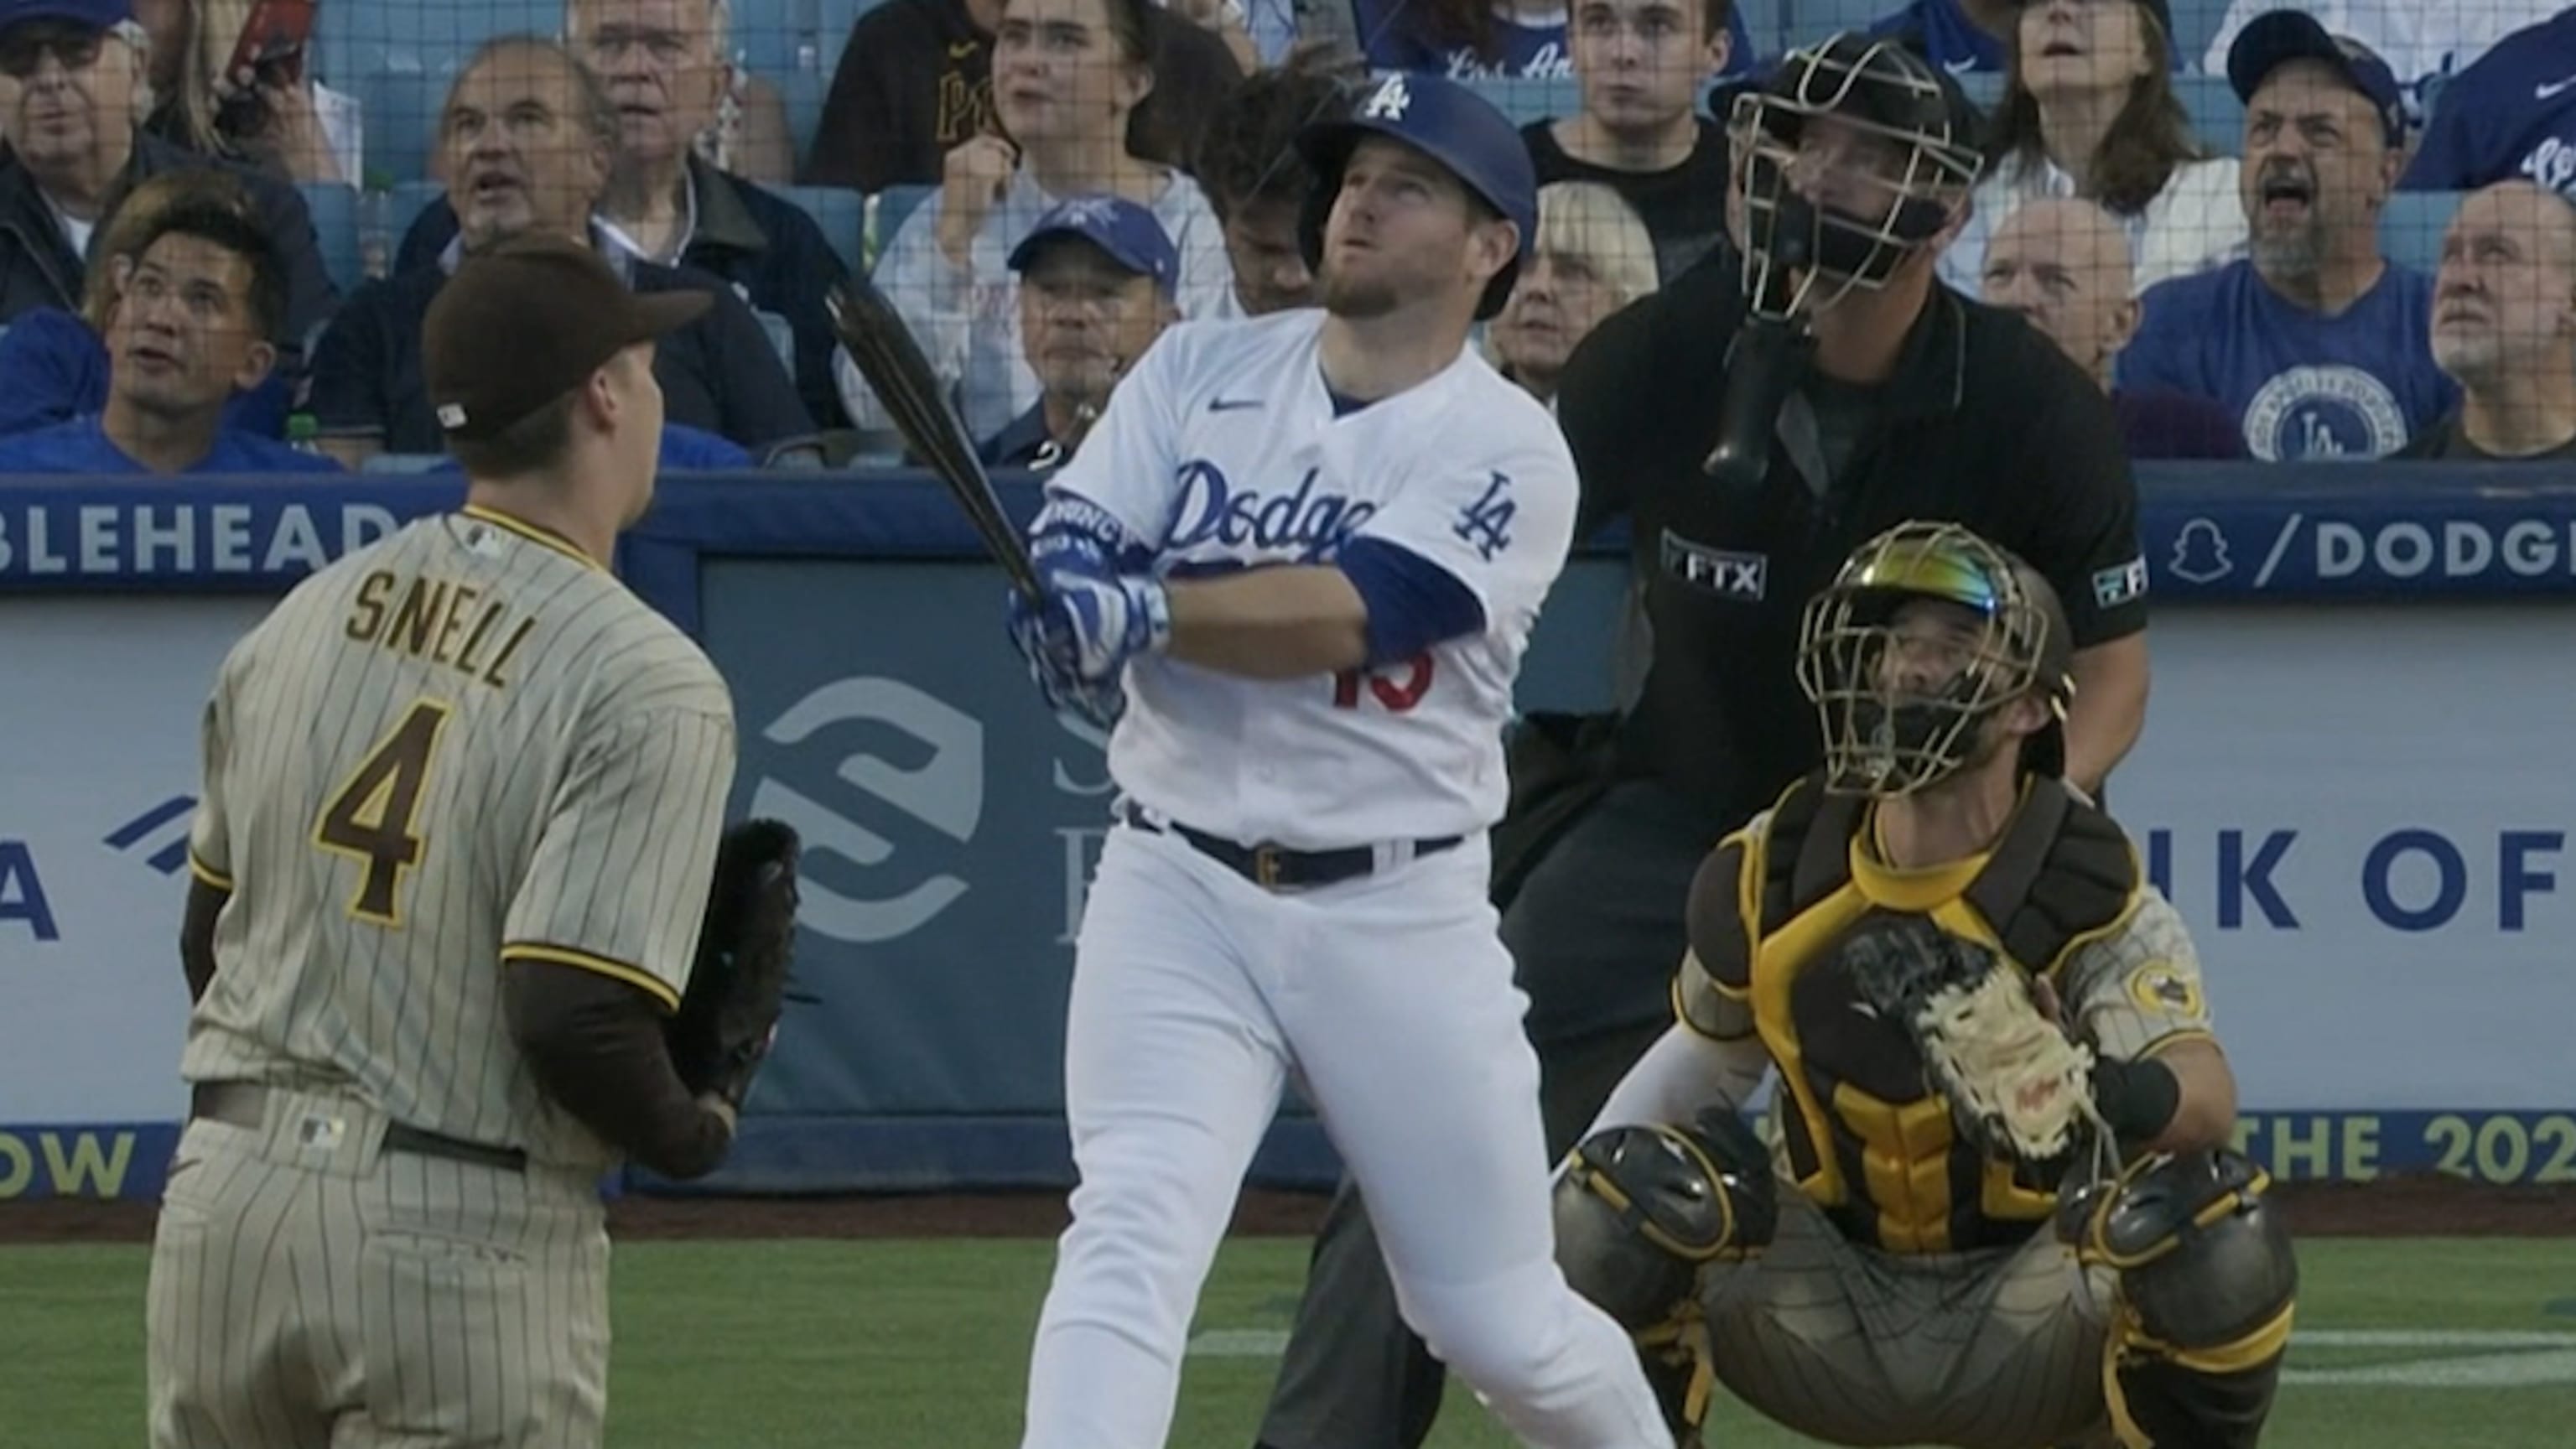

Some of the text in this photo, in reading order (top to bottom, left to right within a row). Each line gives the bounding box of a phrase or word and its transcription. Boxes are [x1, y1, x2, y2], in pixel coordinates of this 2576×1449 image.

[1452, 470, 1516, 563] LA
[2254, 512, 2576, 587] /DODG
[1685, 552, 1759, 593] FTX
[346, 570, 537, 688] SNELL
[310, 695, 454, 928] 4
[2361, 828, 2566, 932] OF
